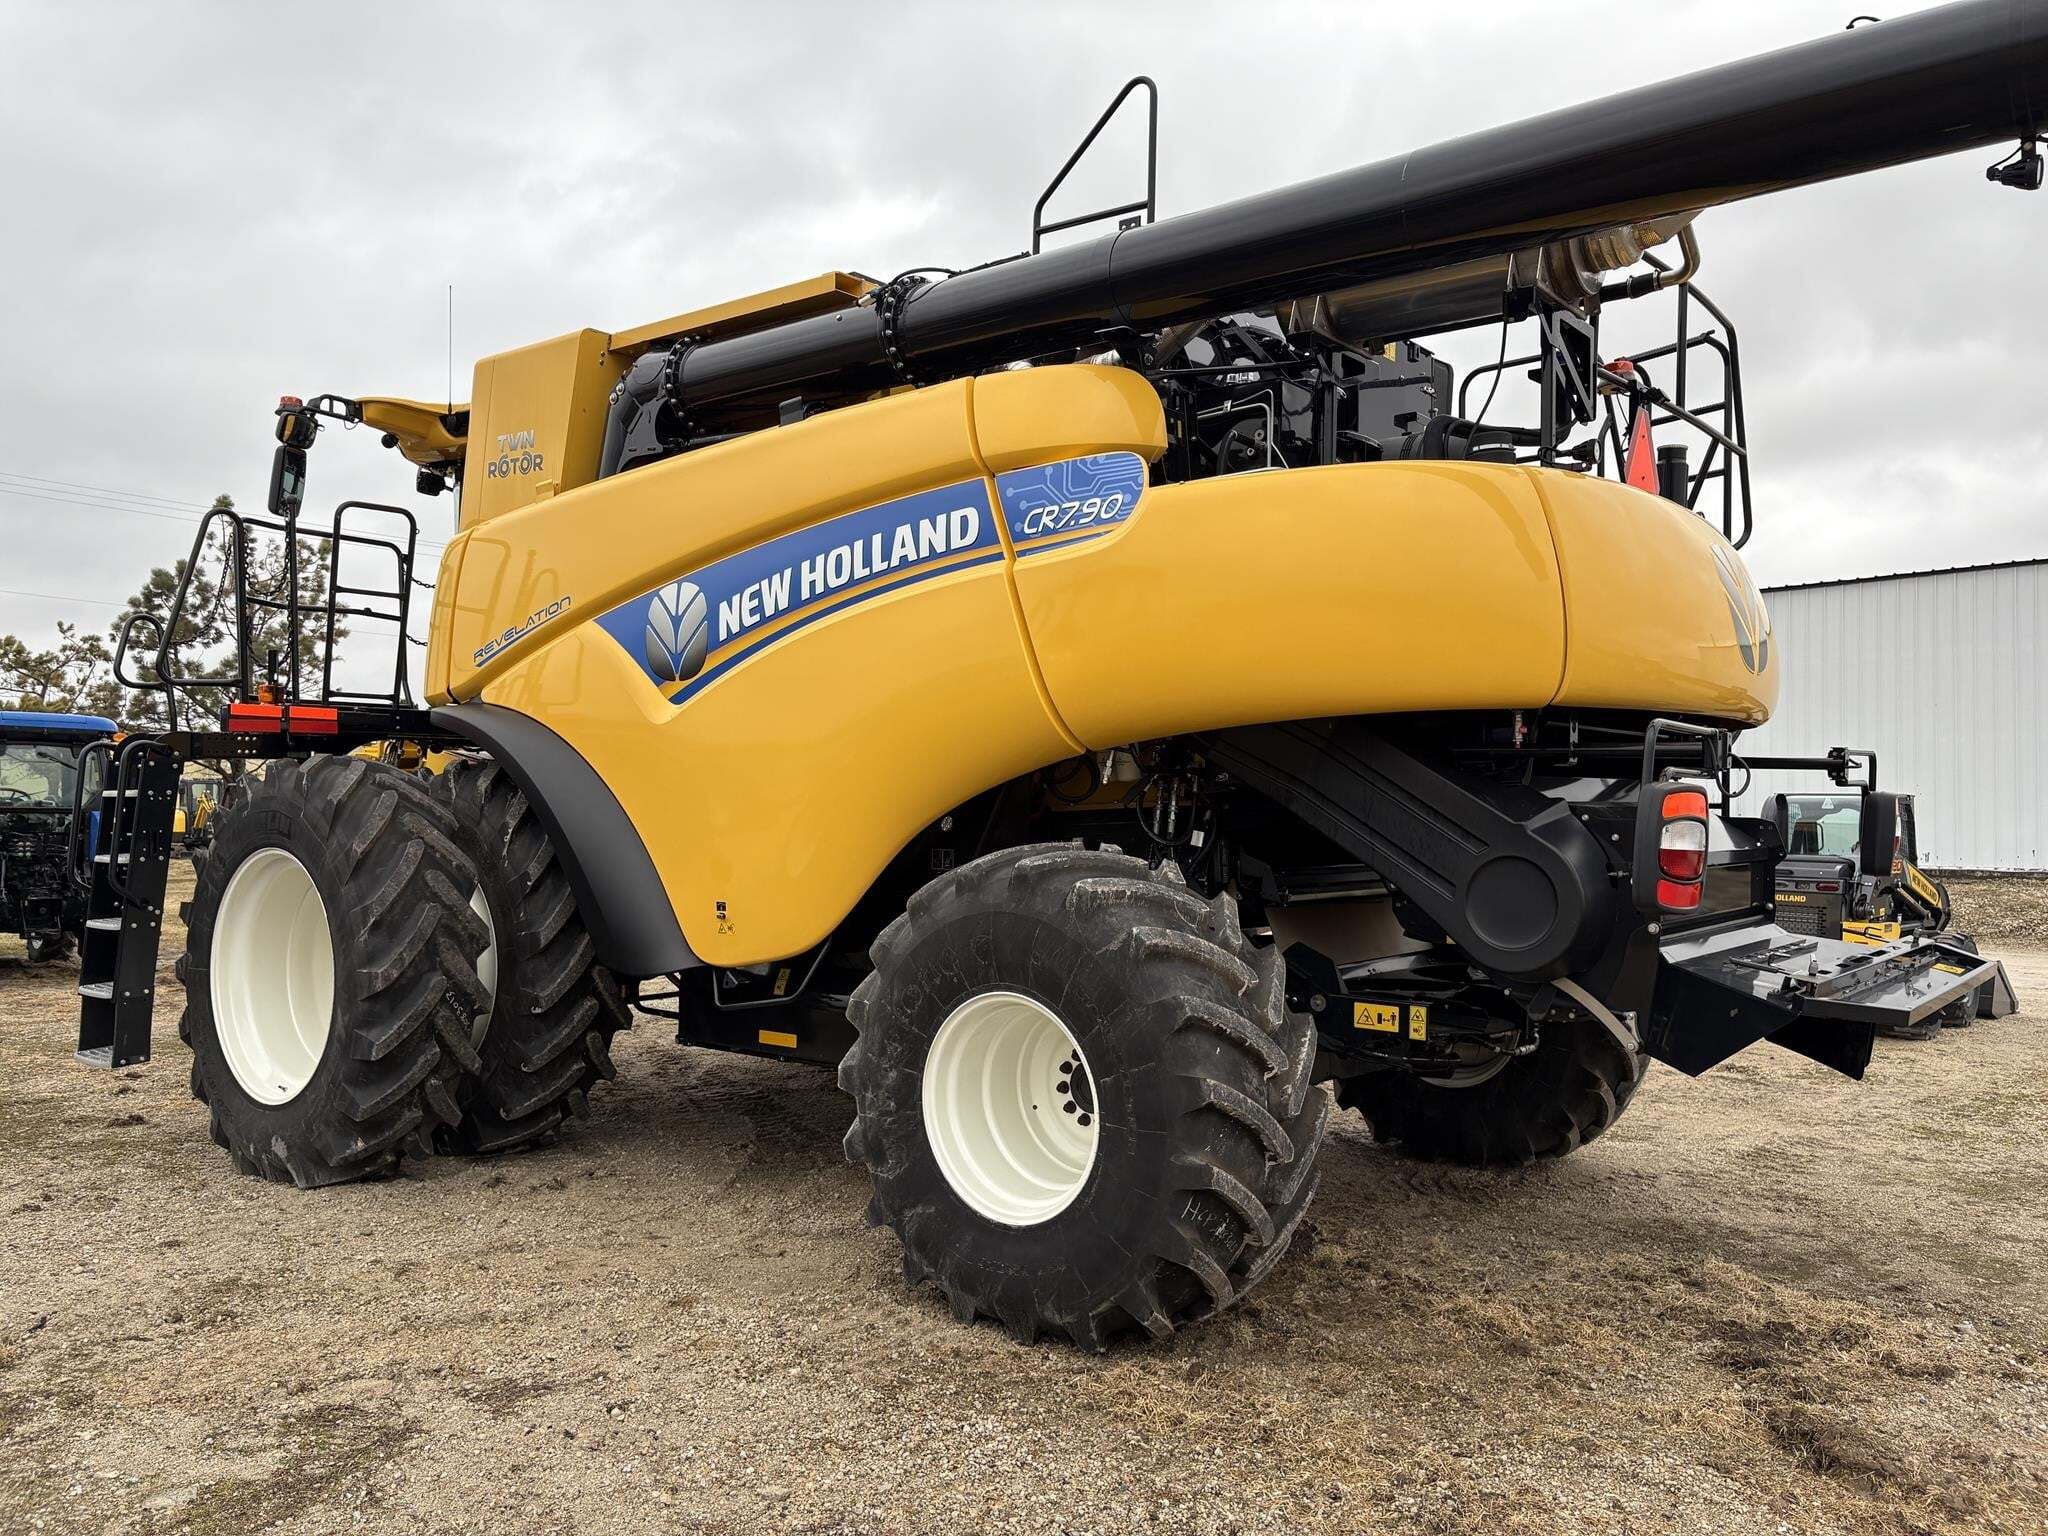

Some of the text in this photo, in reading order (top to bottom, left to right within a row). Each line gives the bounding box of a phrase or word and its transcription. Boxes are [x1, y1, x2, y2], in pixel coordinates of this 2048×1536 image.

[496, 430, 535, 451] TWIN
[487, 451, 544, 479] ROTOR
[1023, 493, 1123, 534] CR7.90
[718, 506, 980, 642] NEW HOLLAND
[473, 595, 571, 663] REVELATION
[1776, 894, 1807, 903] OLLAND
